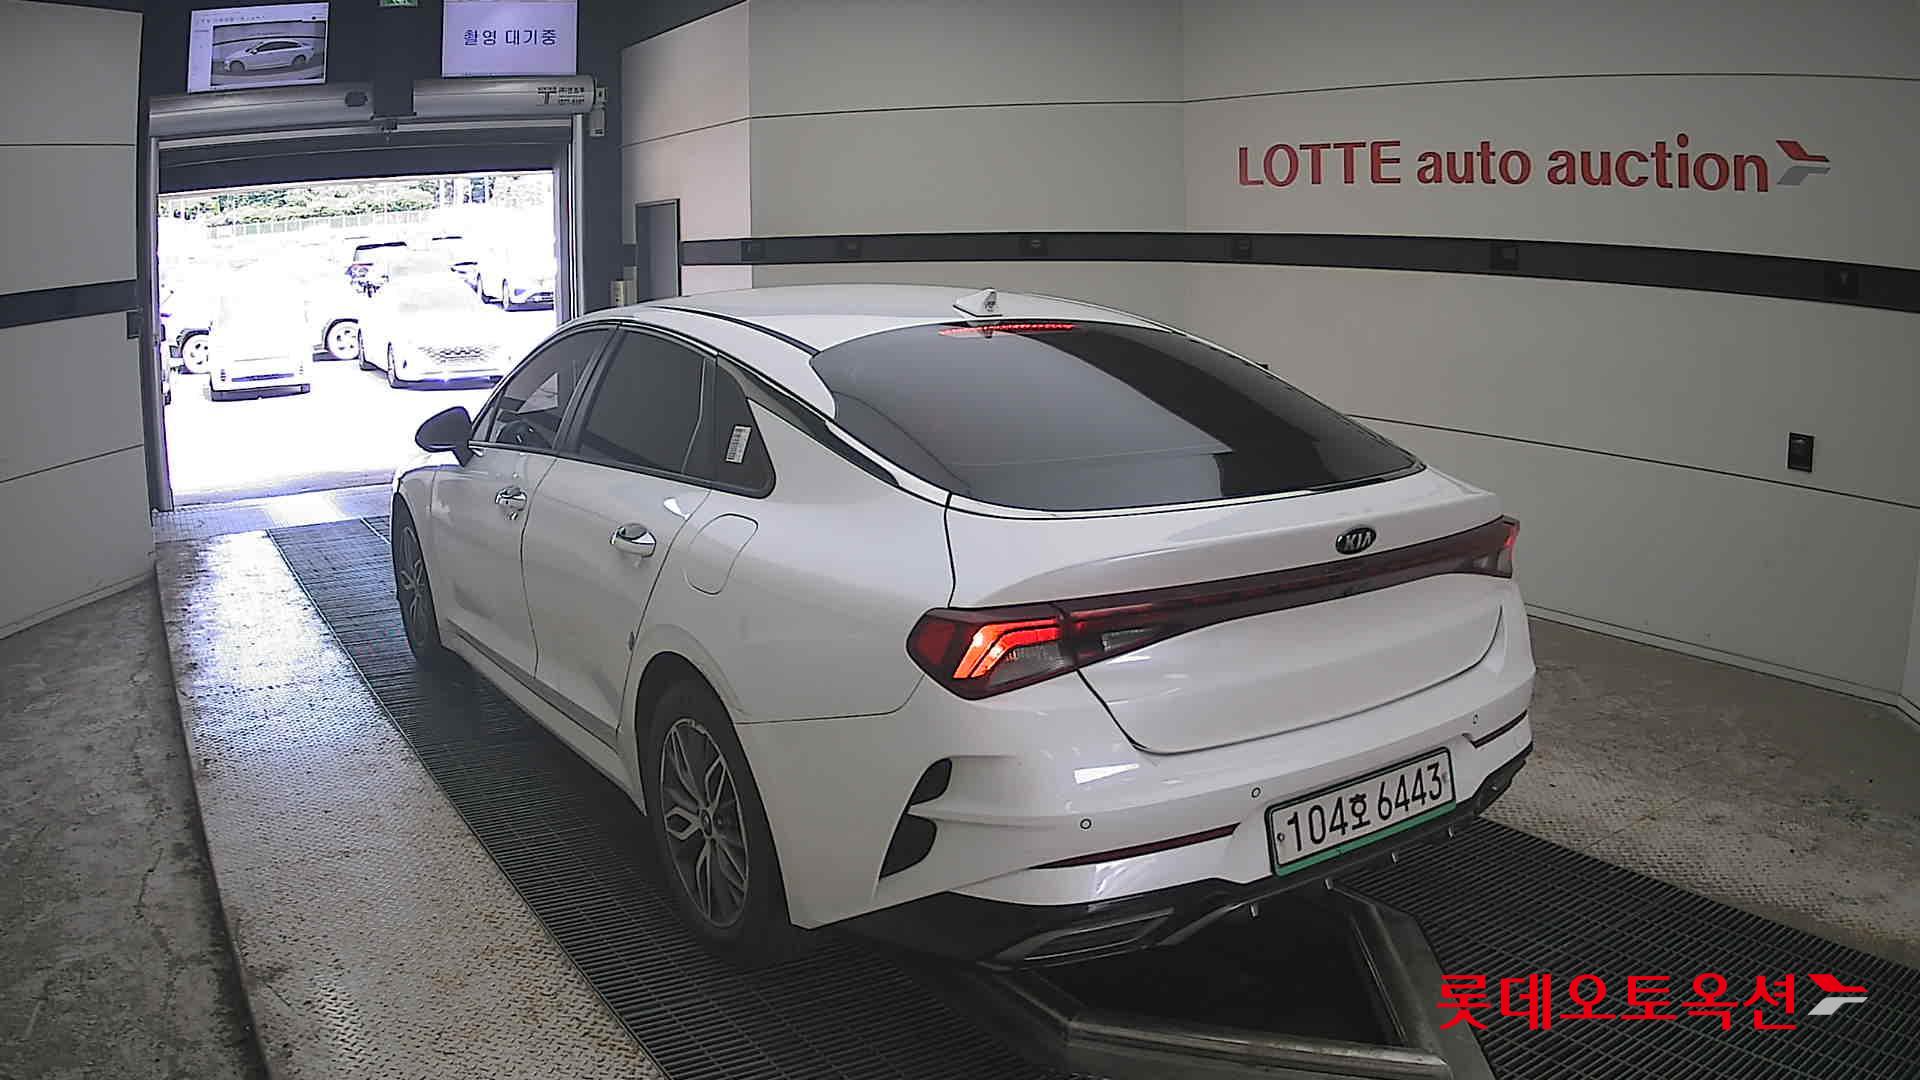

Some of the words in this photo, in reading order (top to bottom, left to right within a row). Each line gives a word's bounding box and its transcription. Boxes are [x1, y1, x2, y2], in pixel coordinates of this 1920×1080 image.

[504, 29, 557, 46] 대기중
[1238, 140, 1401, 187] LOTTE
[1416, 141, 1532, 185] auto
[1546, 133, 1769, 193] auction
[1286, 792, 1371, 852] 104호
[1376, 761, 1443, 821] 6443
